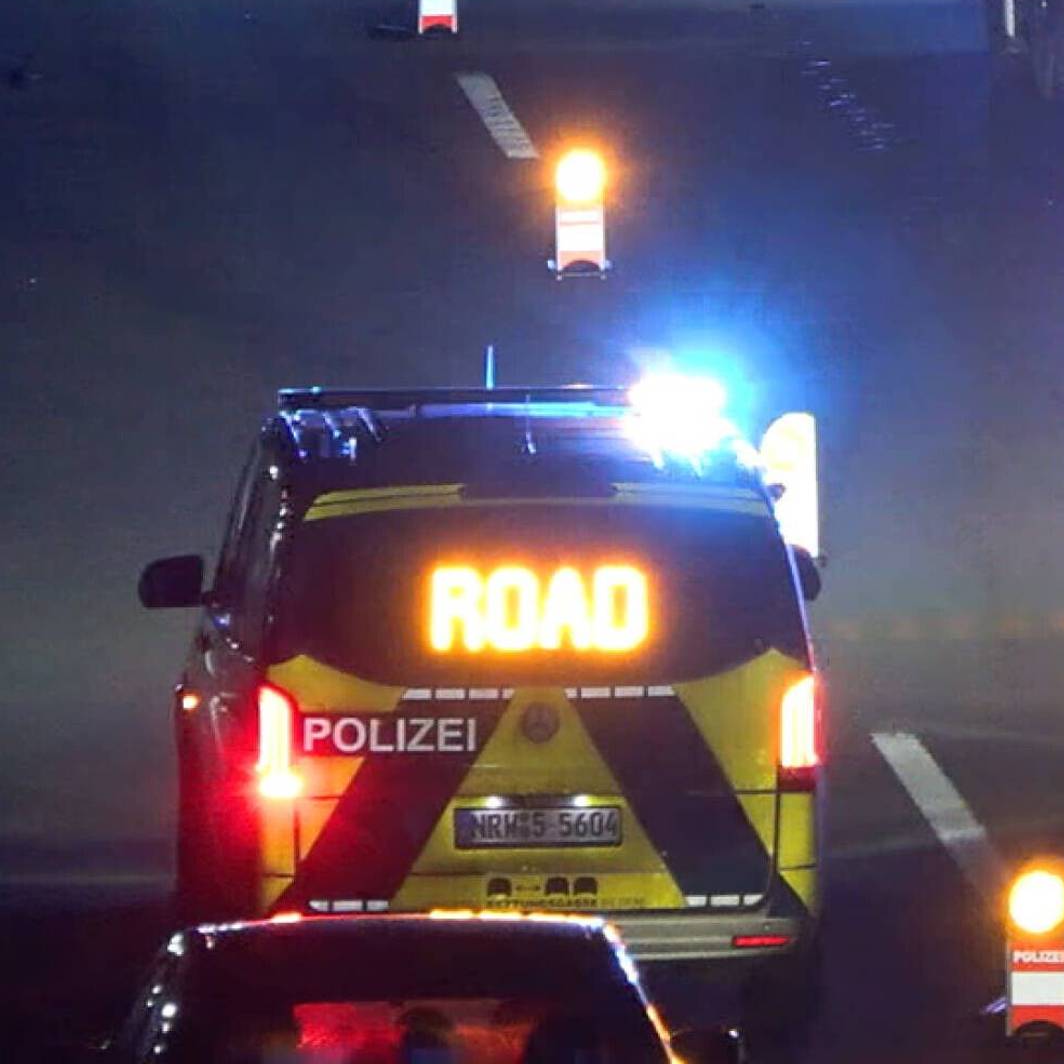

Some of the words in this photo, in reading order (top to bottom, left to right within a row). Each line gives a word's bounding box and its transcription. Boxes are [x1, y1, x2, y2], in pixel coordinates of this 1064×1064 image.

[428, 566, 650, 651] ROAD
[302, 717, 478, 753] POLIZEI
[471, 813, 518, 839] NRW
